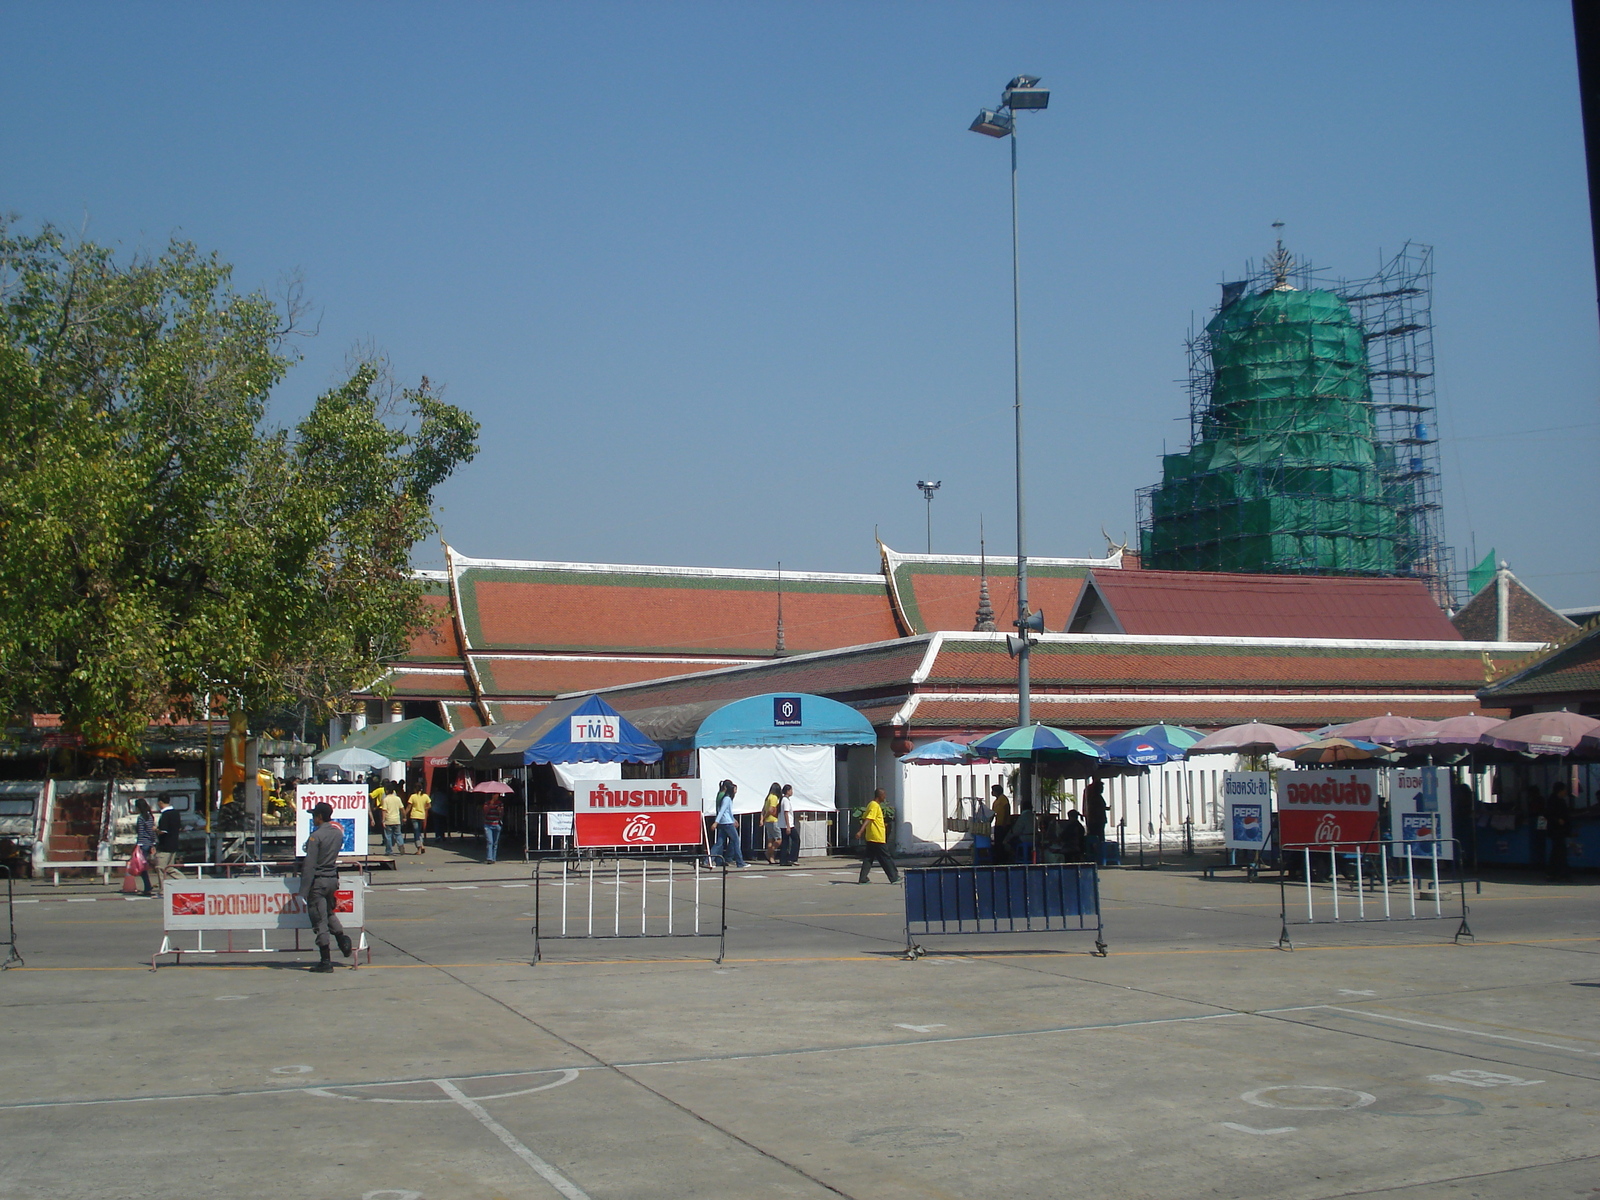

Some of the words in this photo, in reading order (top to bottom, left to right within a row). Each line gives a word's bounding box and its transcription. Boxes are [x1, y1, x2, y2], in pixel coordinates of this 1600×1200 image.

[576, 720, 614, 738] TMB
[589, 782, 688, 808] ห้ามรถเข้า
[1287, 774, 1371, 806] จอดรับส่ง
[1234, 808, 1260, 817] PEPSI
